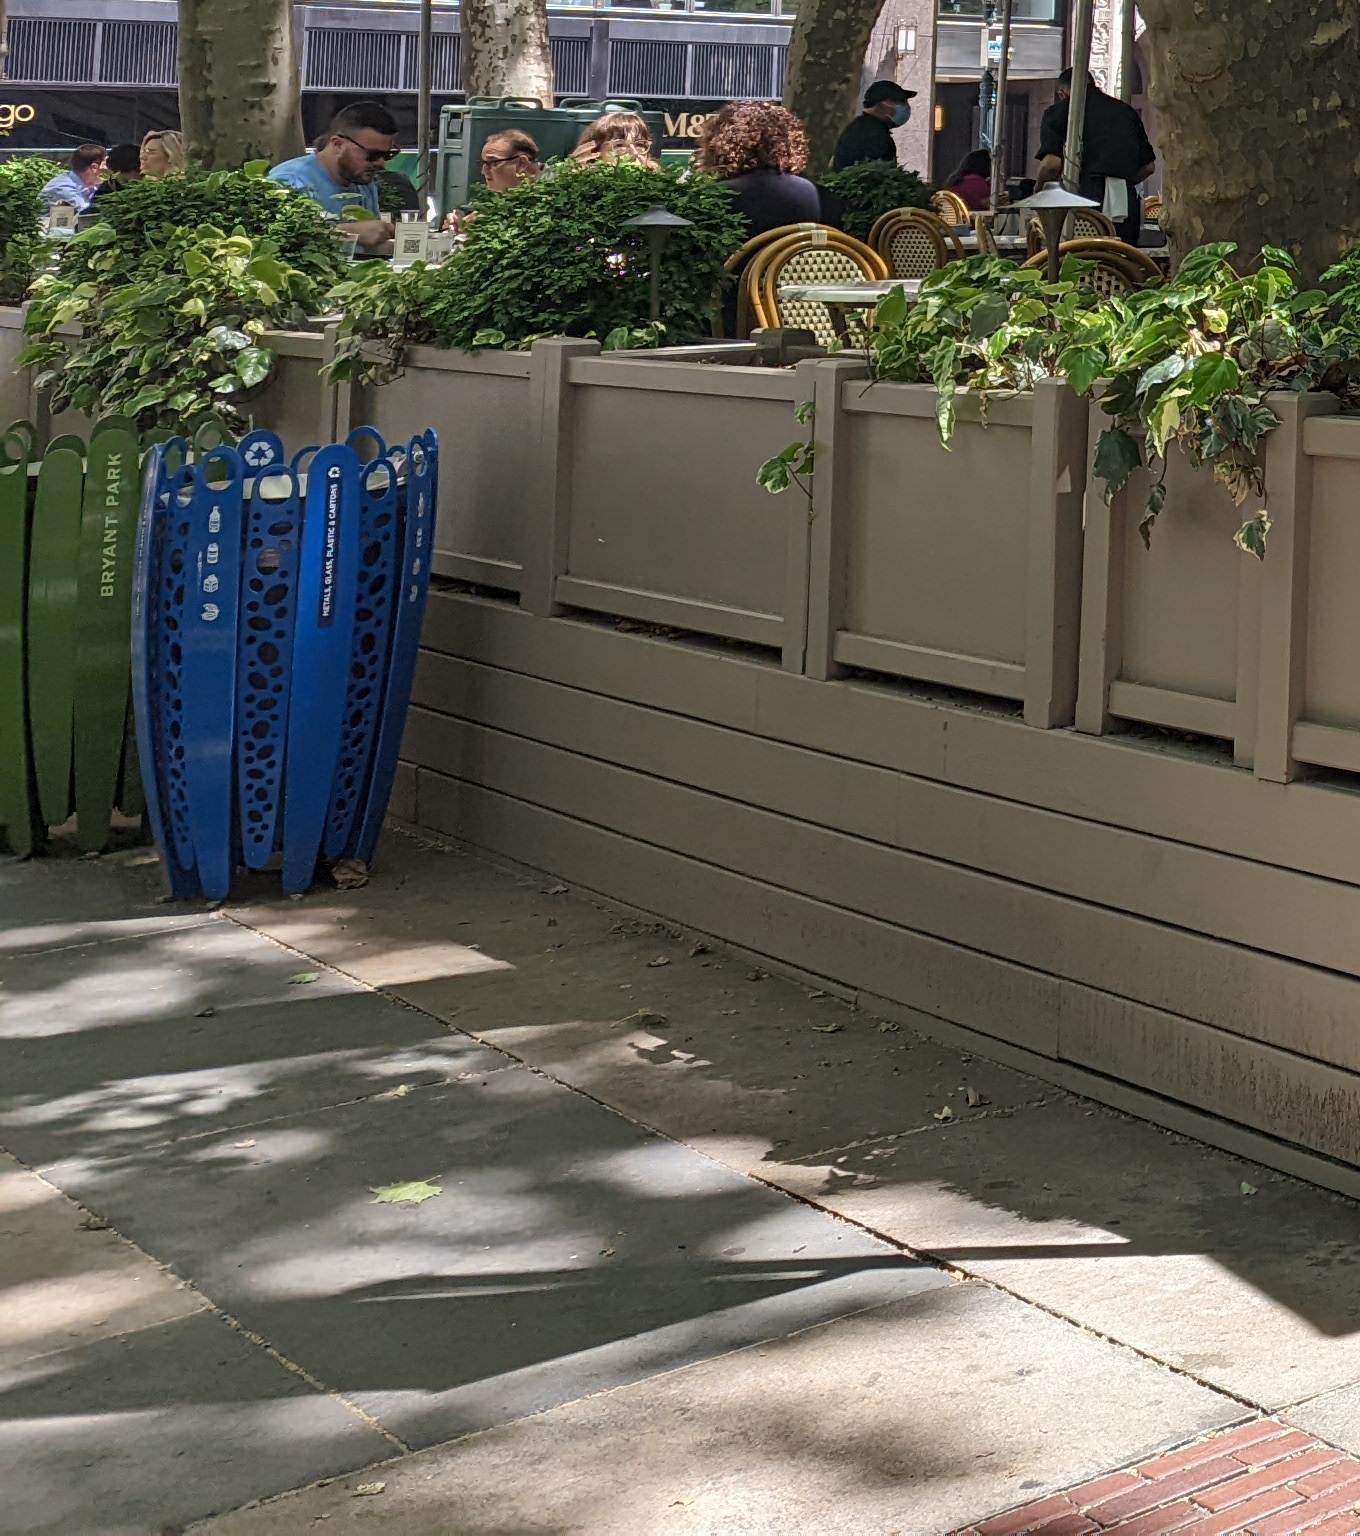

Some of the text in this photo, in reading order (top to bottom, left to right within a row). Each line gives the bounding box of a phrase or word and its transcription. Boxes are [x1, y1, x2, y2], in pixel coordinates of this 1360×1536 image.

[100, 453, 122, 597] BRYANT PARK
[326, 527, 336, 558] PLASTIC
[324, 559, 333, 585] GLASS,
[322, 585, 332, 617] METALS,
